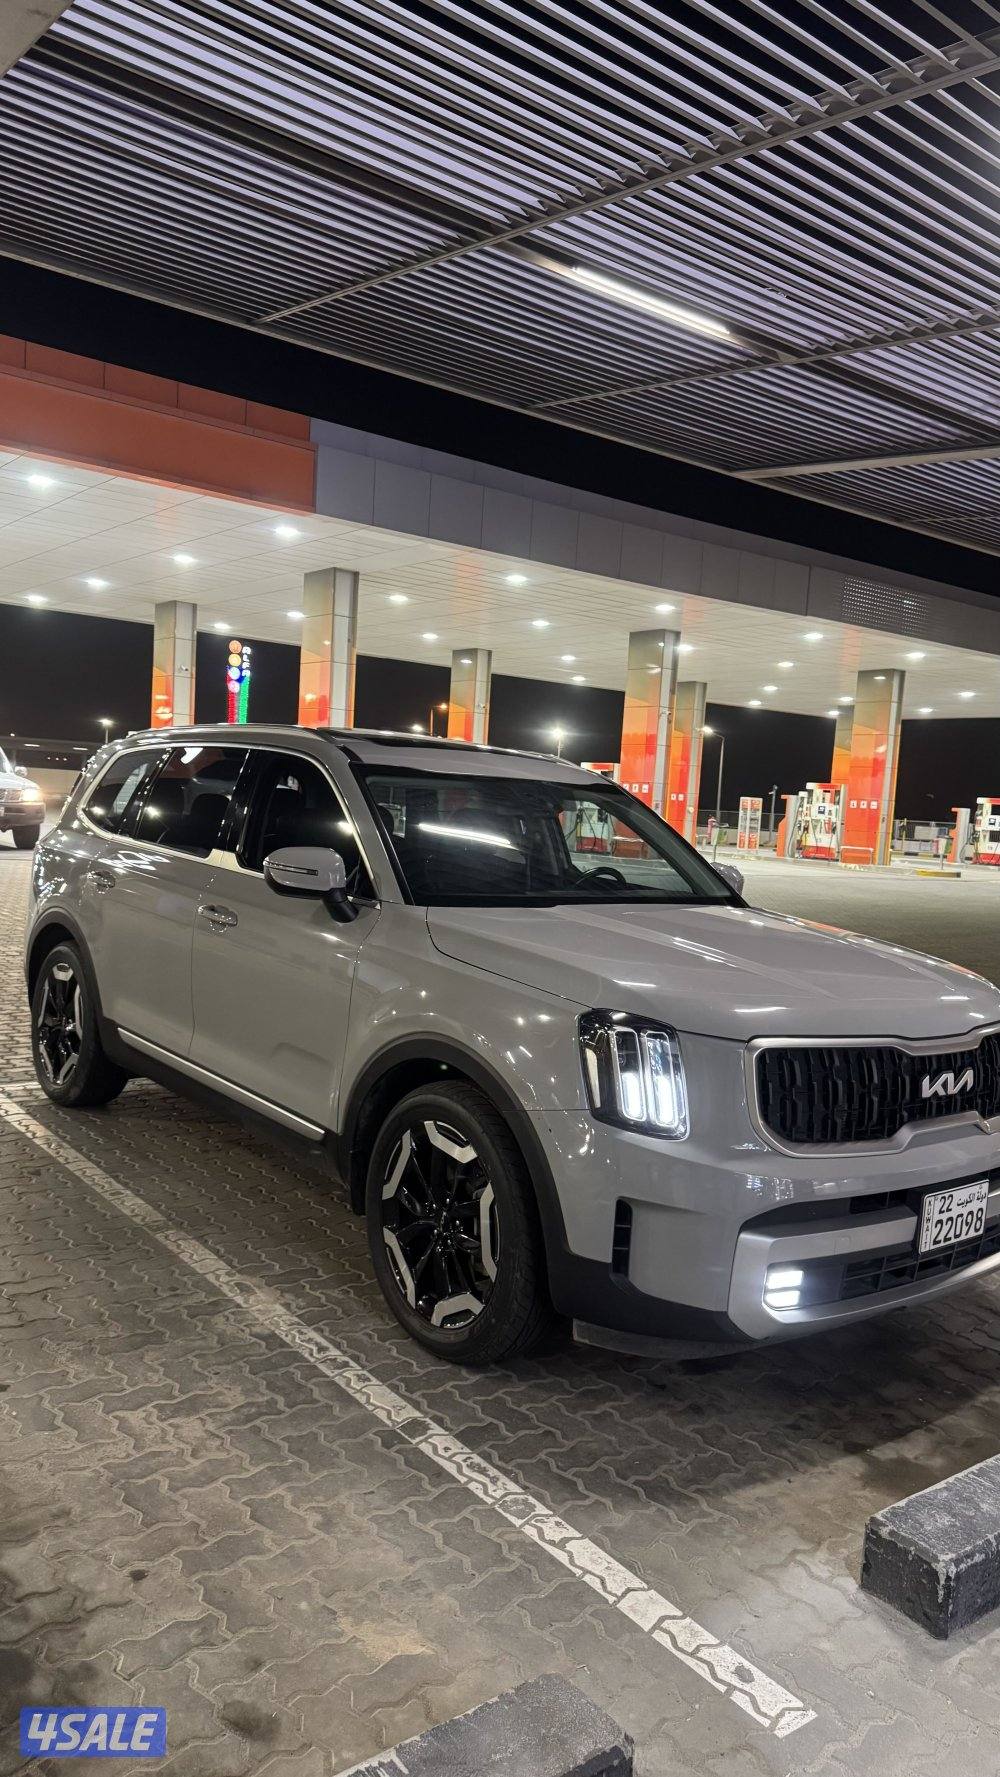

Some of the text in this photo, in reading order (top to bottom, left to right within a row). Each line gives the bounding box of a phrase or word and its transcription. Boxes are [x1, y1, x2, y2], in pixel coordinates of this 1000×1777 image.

[938, 1194, 953, 1214] 22
[956, 1190, 987, 1208] دولة الكويت
[923, 1199, 932, 1248] KUWAIT
[932, 1207, 984, 1246] 22098
